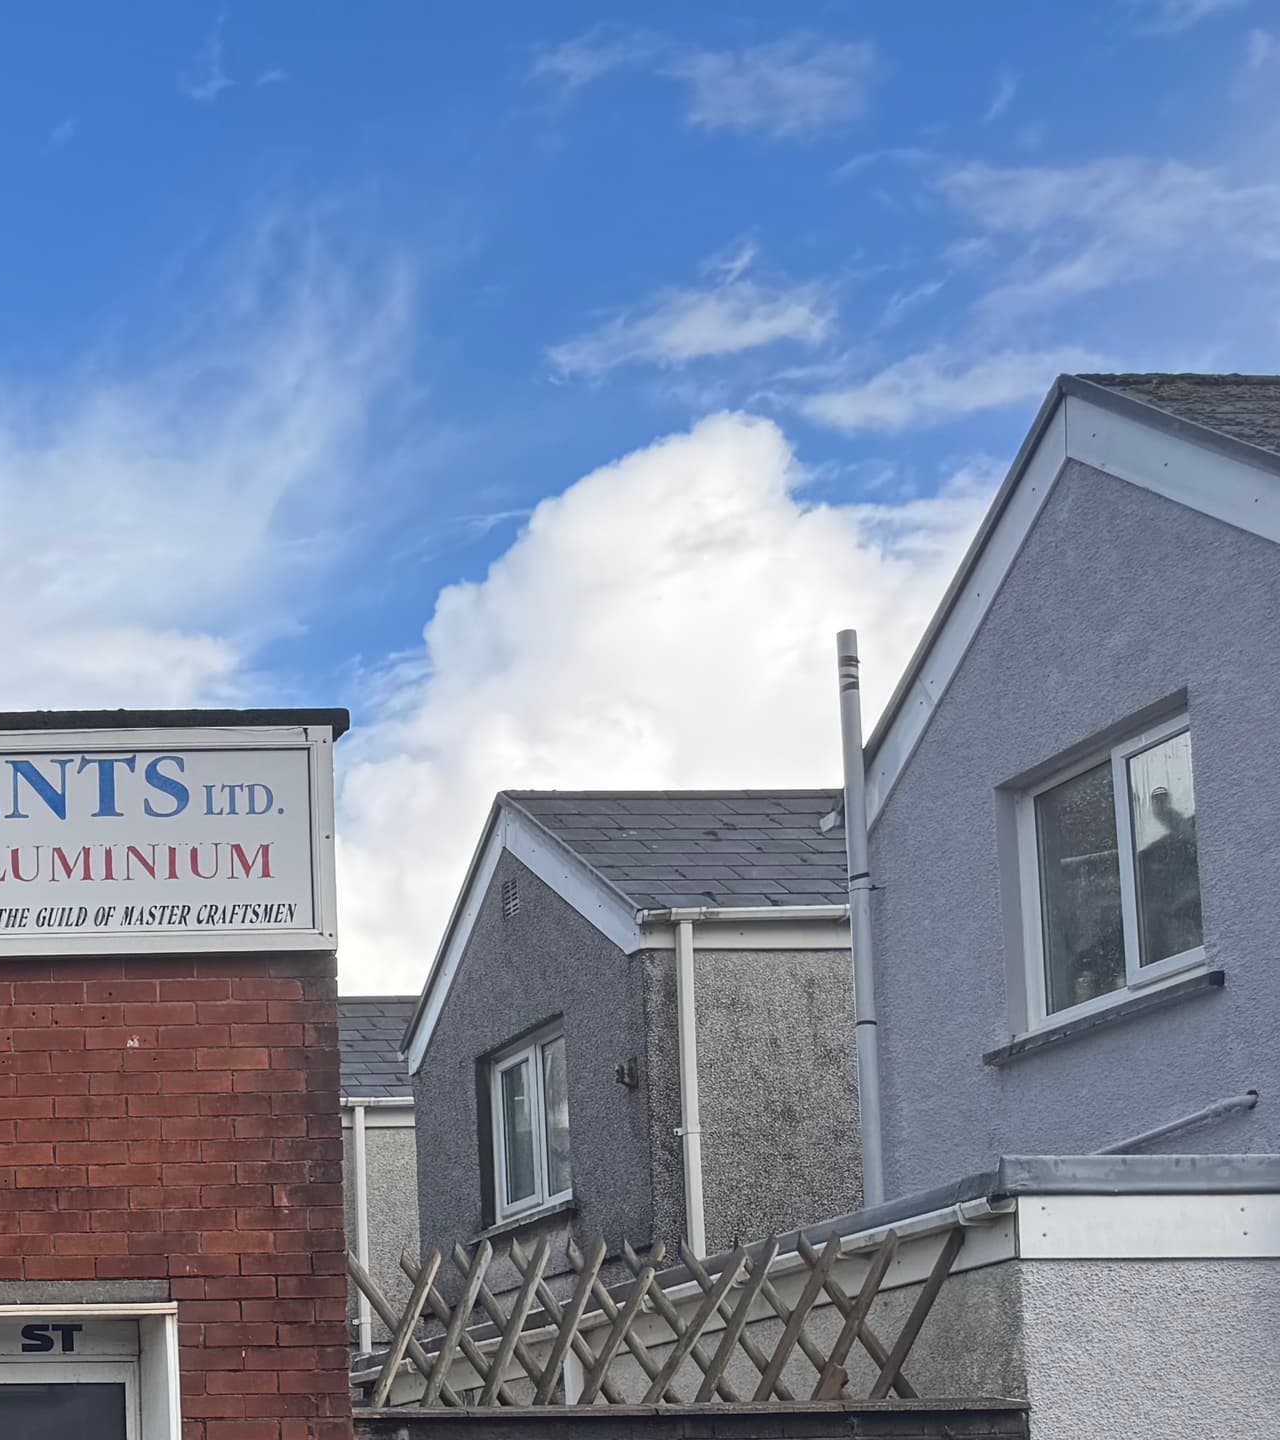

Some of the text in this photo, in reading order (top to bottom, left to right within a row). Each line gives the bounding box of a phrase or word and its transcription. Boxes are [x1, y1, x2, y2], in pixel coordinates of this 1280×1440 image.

[202, 783, 285, 816] LTD.
[35, 905, 88, 929] GUILD
[93, 905, 116, 928] OF
[119, 904, 191, 928] MASTER
[195, 902, 298, 927] CRAFTSMEN
[20, 1323, 83, 1353] ST
